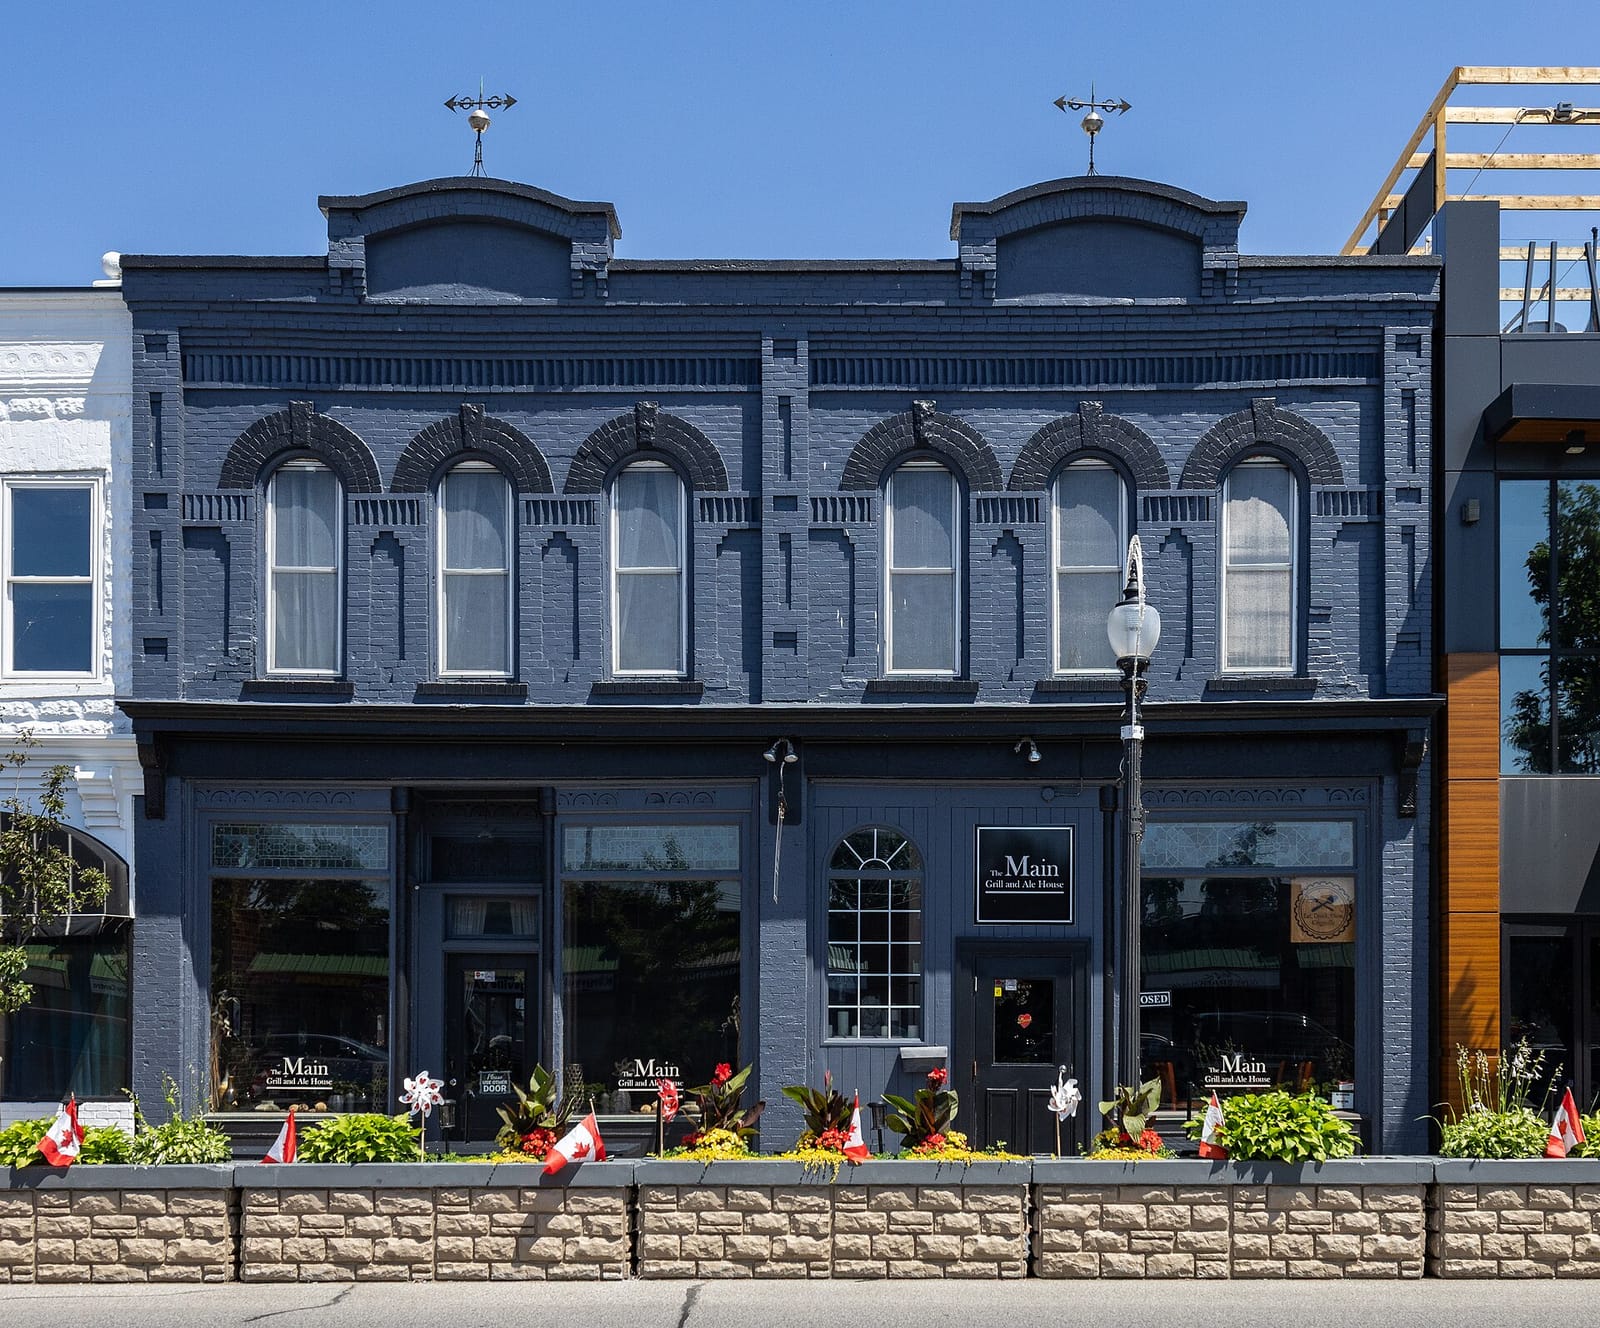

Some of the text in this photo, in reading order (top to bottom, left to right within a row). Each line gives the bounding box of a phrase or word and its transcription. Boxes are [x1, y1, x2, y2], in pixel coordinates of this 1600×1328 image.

[1004, 855, 1059, 877] Main
[985, 880, 1064, 888] Grill and Ale House
[1140, 994, 1168, 1004] OSED
[282, 1057, 328, 1075] Main
[634, 1059, 680, 1077] Main
[1220, 1054, 1266, 1073] Main
[266, 1077, 332, 1085] Grill and Ale House
[618, 1079, 634, 1087] Grill
[634, 1079, 648, 1087] and
[1204, 1075, 1271, 1083] Grill and Ale House
